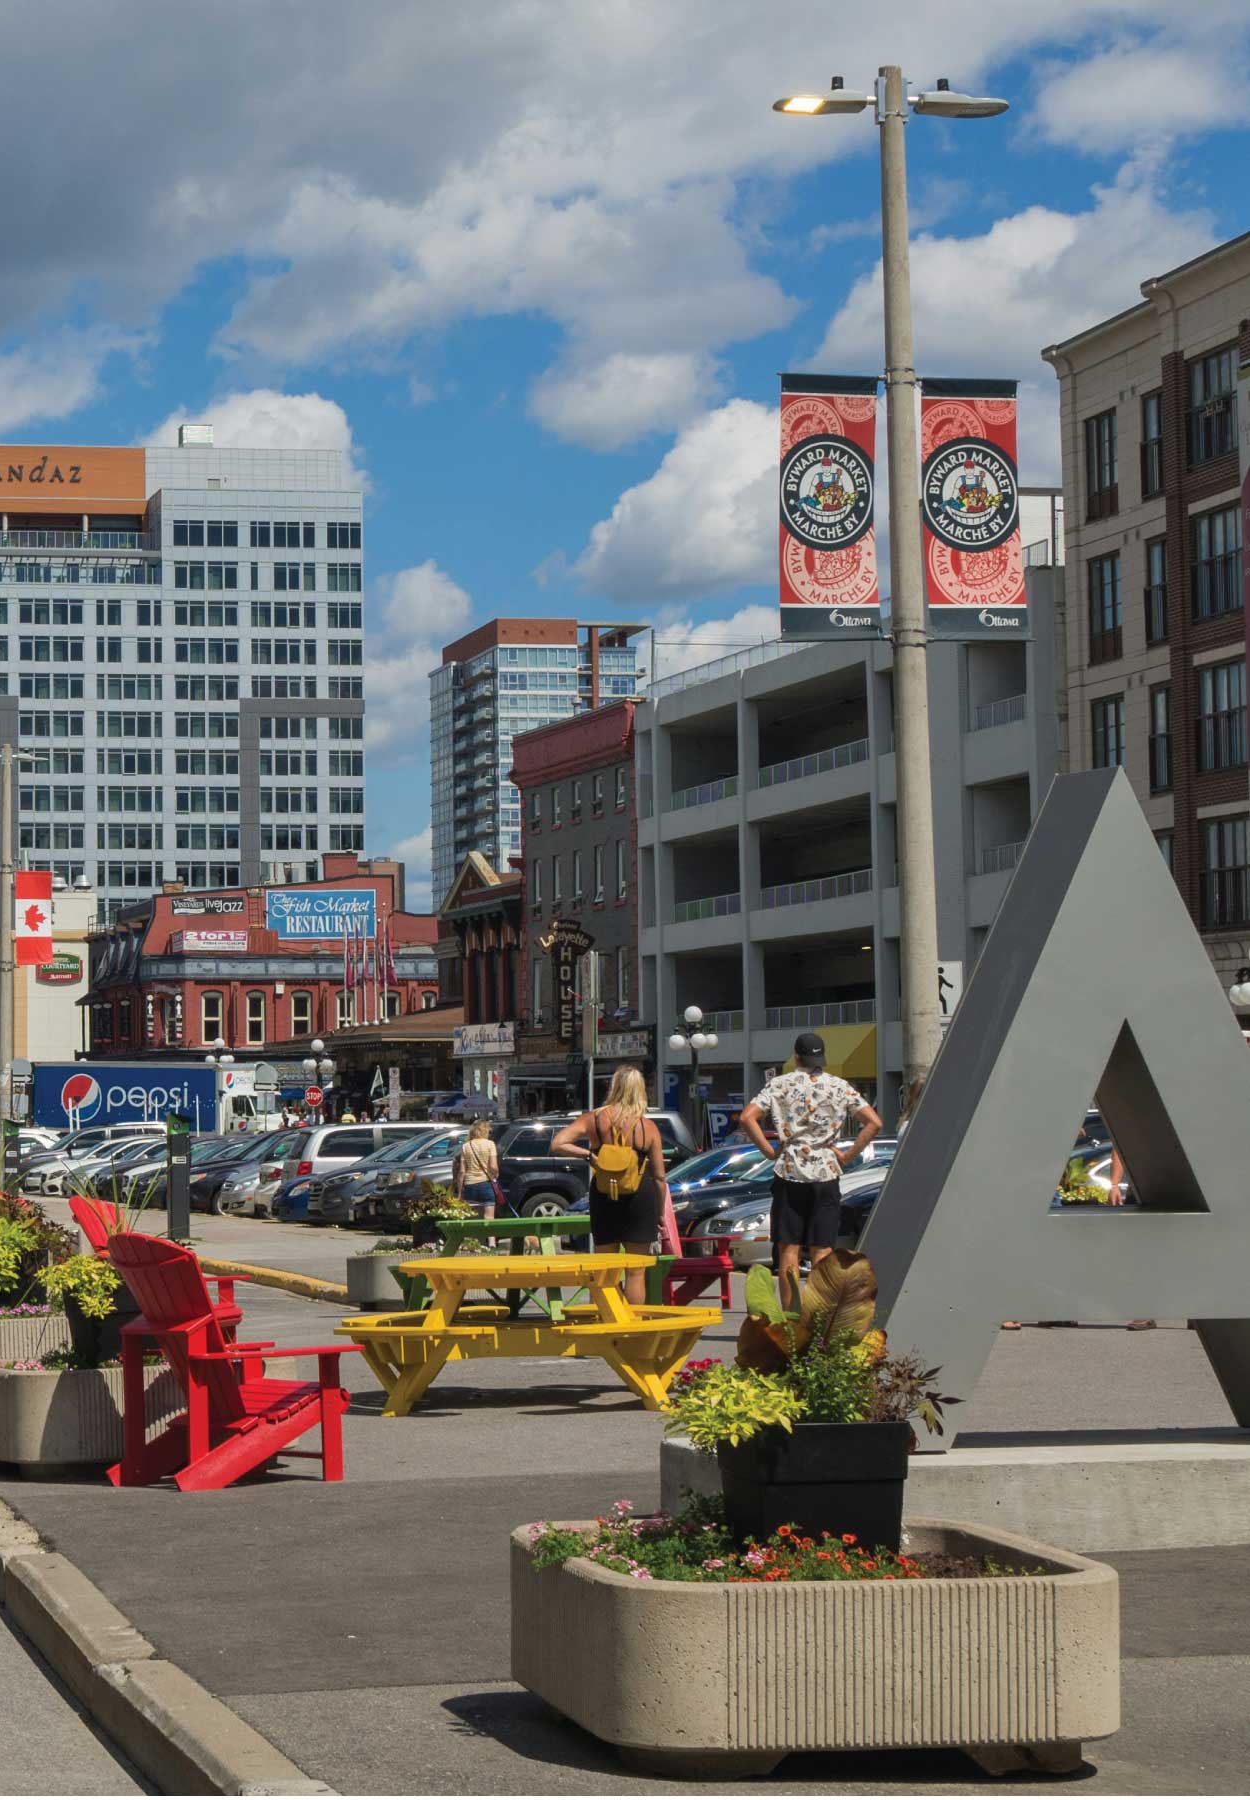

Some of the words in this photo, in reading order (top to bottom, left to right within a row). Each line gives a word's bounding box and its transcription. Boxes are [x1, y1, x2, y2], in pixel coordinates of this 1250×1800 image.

[786, 448, 825, 491] BYWARD
[828, 448, 868, 493] MARKET
[929, 451, 967, 494] BYWARD
[971, 451, 1012, 495] MARKET
[791, 511, 844, 538] MARCHÉ
[843, 513, 859, 531] BY
[936, 513, 990, 540] MARCHÉ
[988, 514, 1004, 532] BY
[791, 543, 803, 574] BYW
[937, 545, 949, 575] BYW
[861, 566, 874, 584] BY
[1008, 567, 1022, 584] BY
[829, 609, 871, 627] Ottawa
[978, 608, 1019, 627] Ottawa
[271, 893, 290, 904] The
[271, 897, 312, 918] Fish
[313, 897, 370, 913] Market
[286, 914, 369, 933] RESTAURANT
[185, 931, 198, 940] 2
[199, 931, 227, 940] for
[540, 930, 590, 948] Lafayette
[560, 946, 573, 1038] HOUSE
[664, 1073, 679, 1094] P
[107, 1081, 189, 1114] pepsi
[711, 1112, 728, 1134] P
